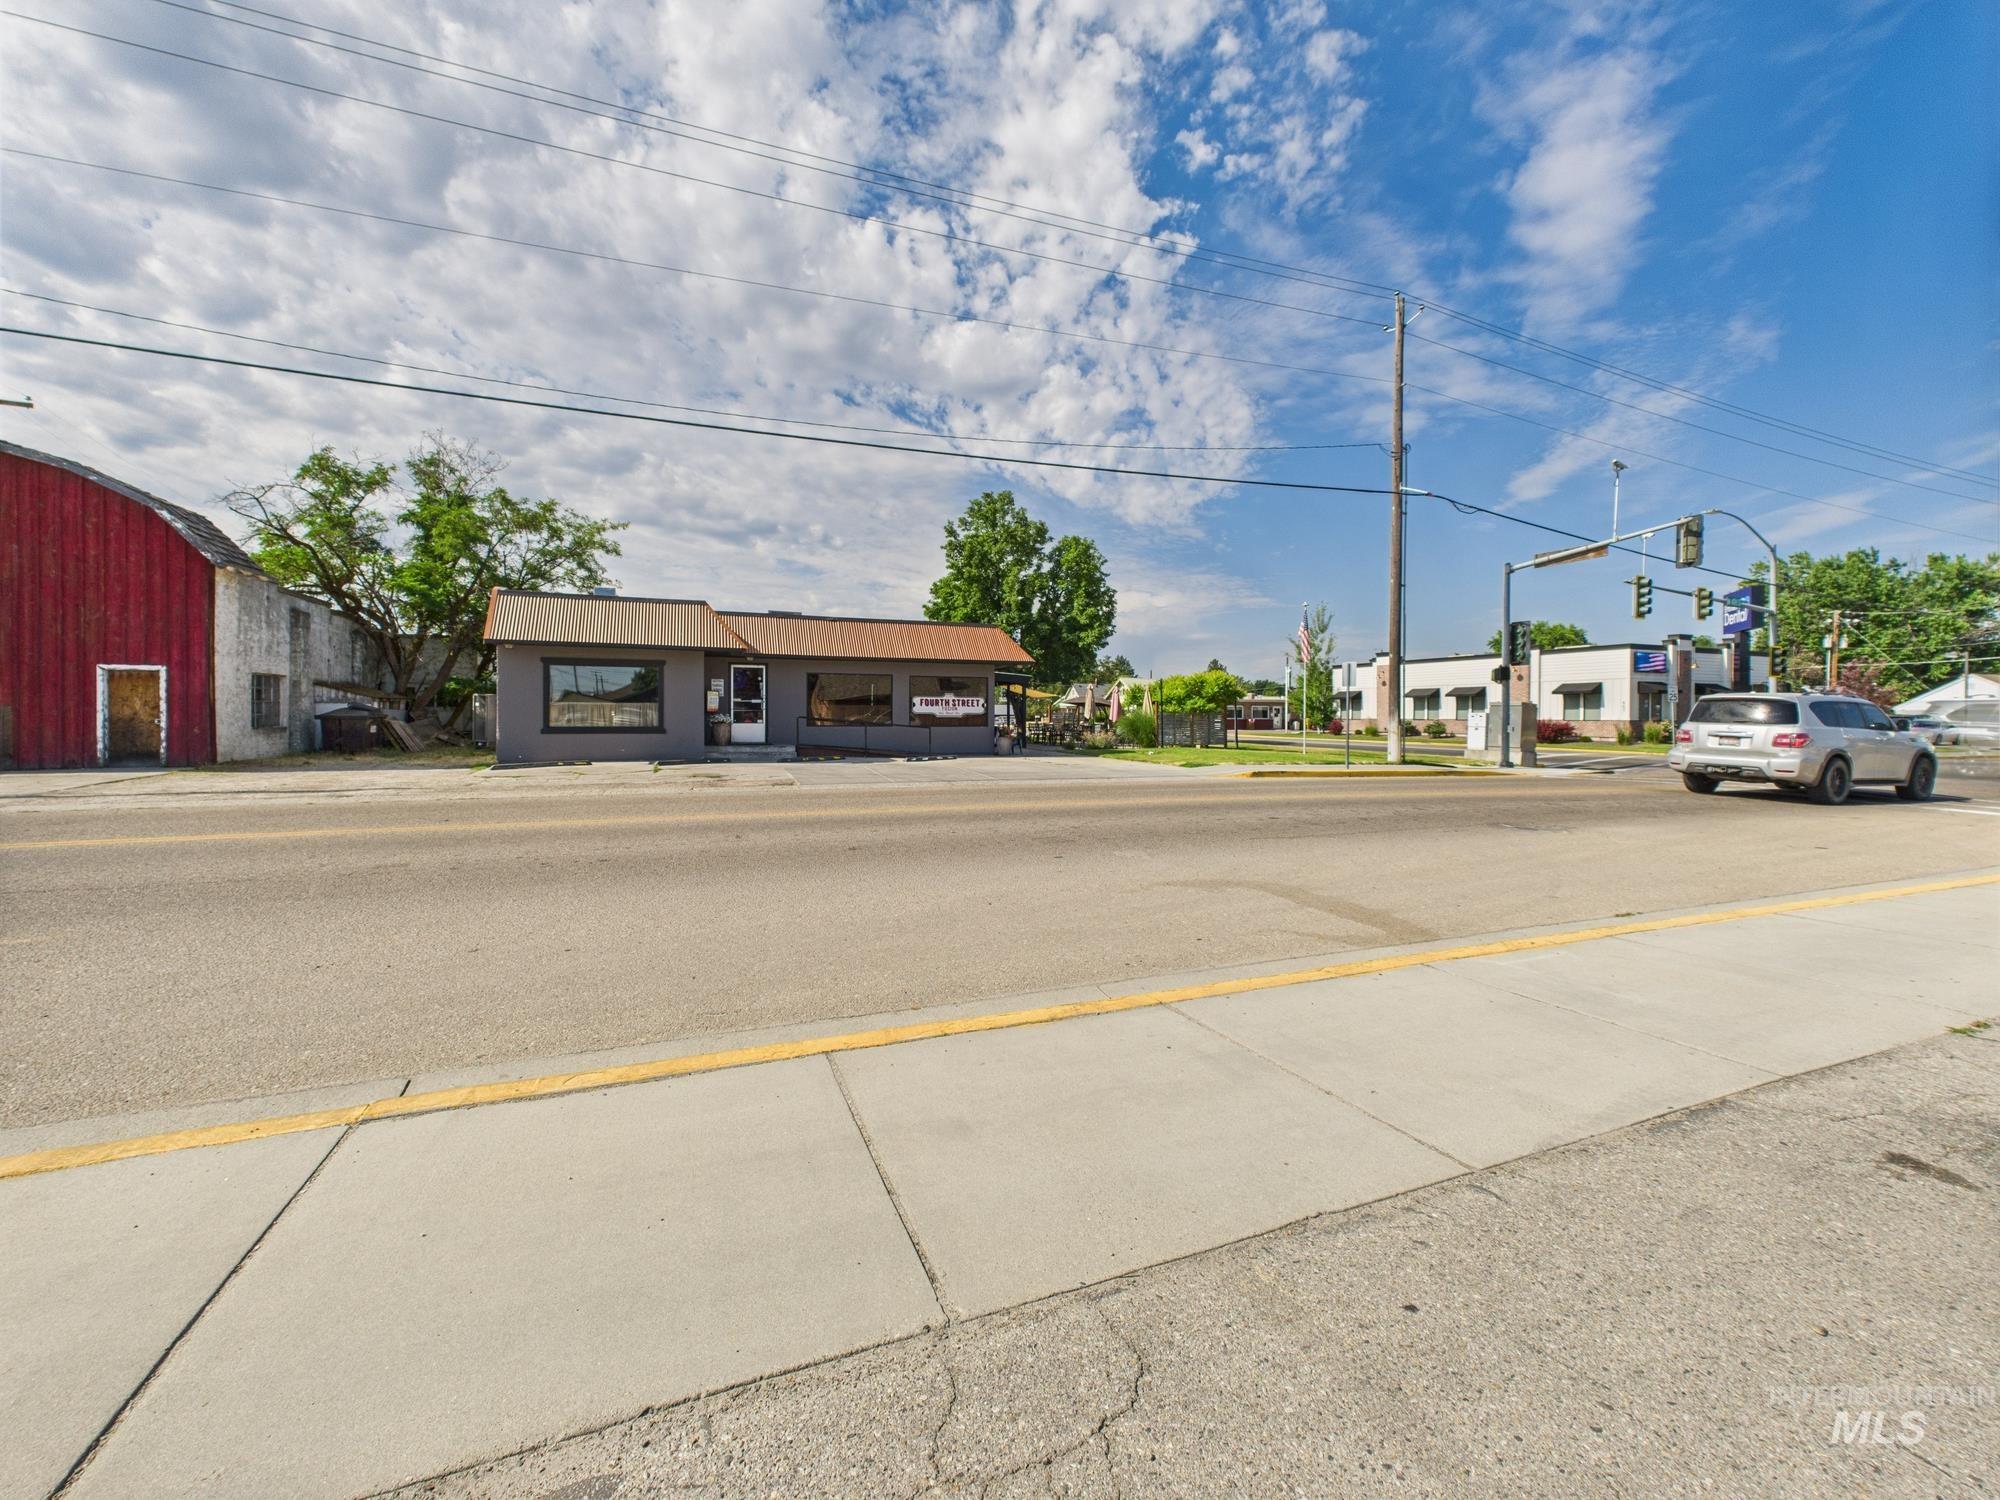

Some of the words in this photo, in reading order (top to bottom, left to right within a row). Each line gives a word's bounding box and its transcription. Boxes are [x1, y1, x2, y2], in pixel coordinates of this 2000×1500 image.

[1669, 693, 1678, 701] 25
[920, 699, 950, 707] FOURTH
[952, 699, 980, 707] STREET
